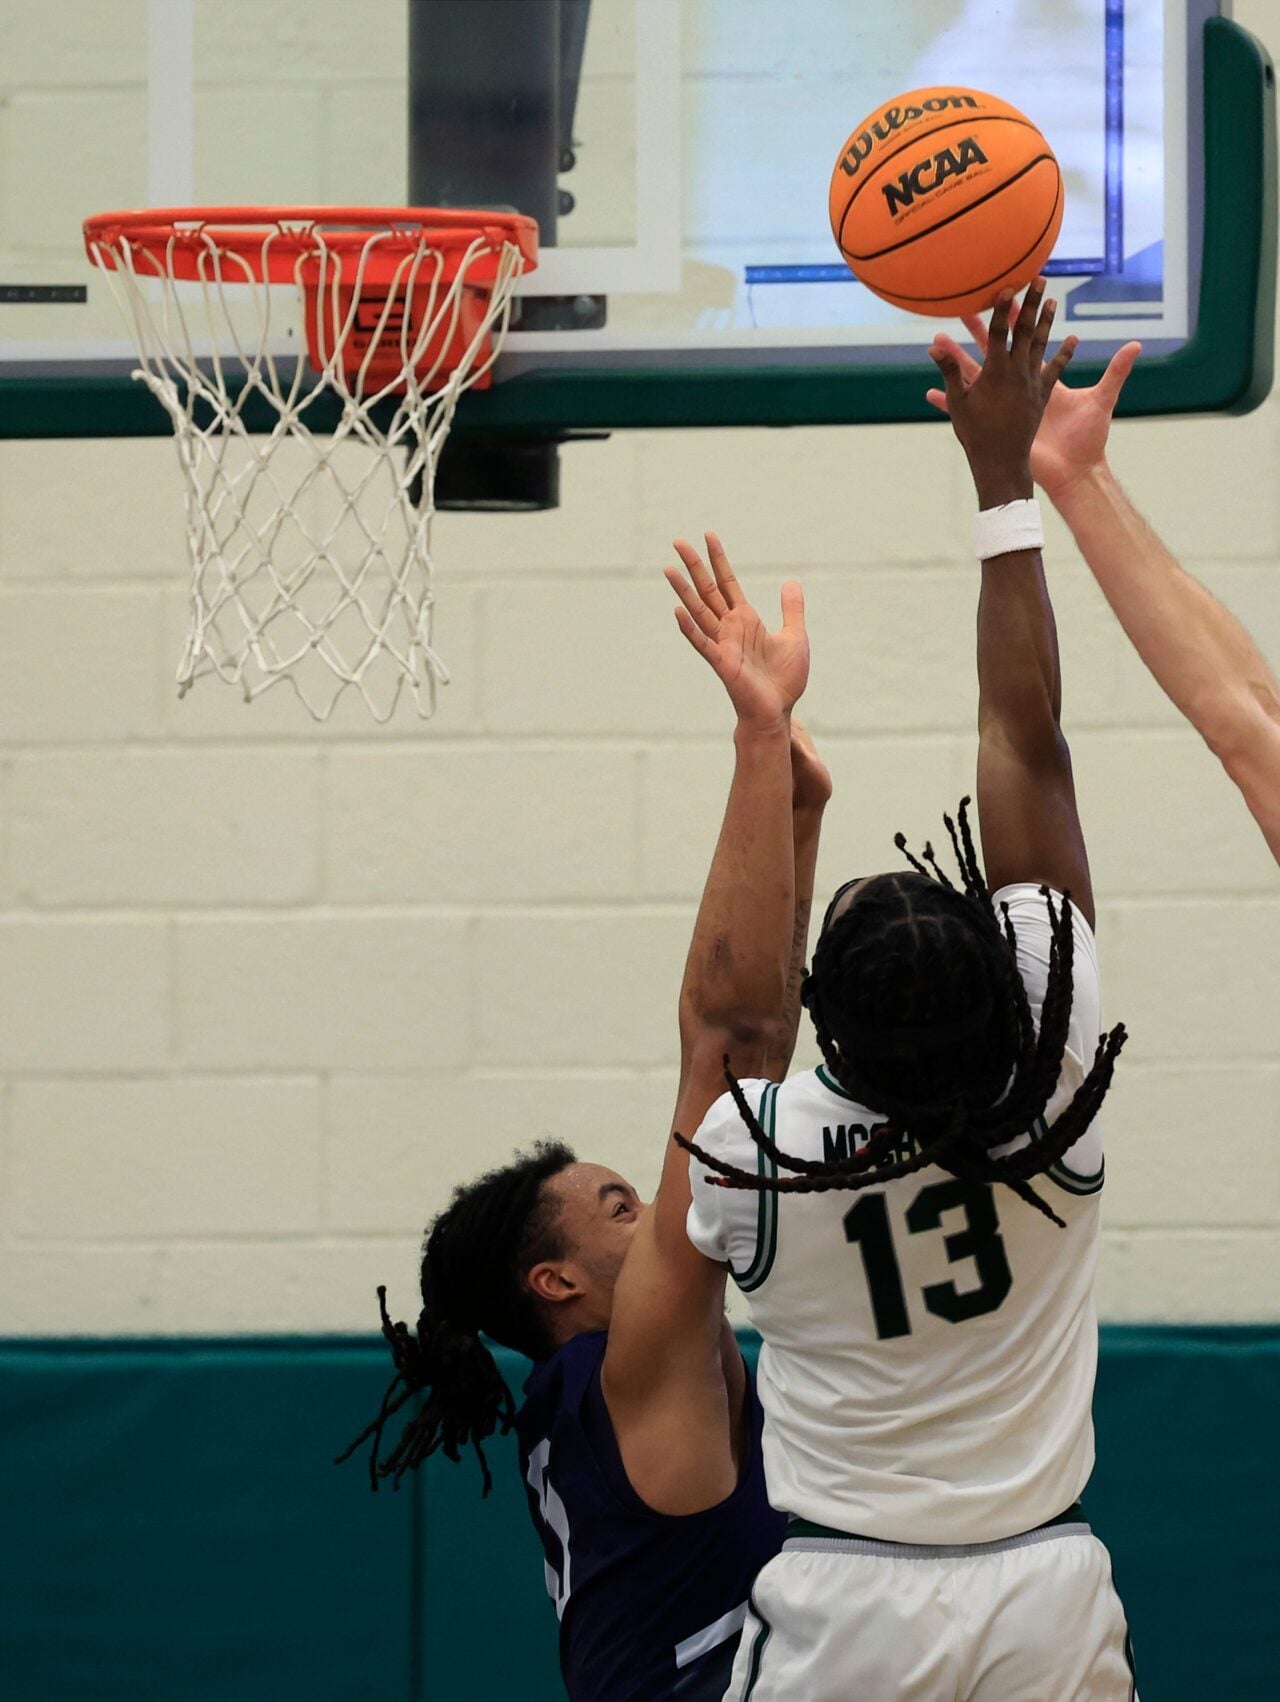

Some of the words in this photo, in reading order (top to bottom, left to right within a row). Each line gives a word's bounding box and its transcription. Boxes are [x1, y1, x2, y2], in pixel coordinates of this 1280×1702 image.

[840, 95, 978, 177] Wilson
[881, 136, 989, 217] NCAA
[842, 1178, 1013, 1340] 13
